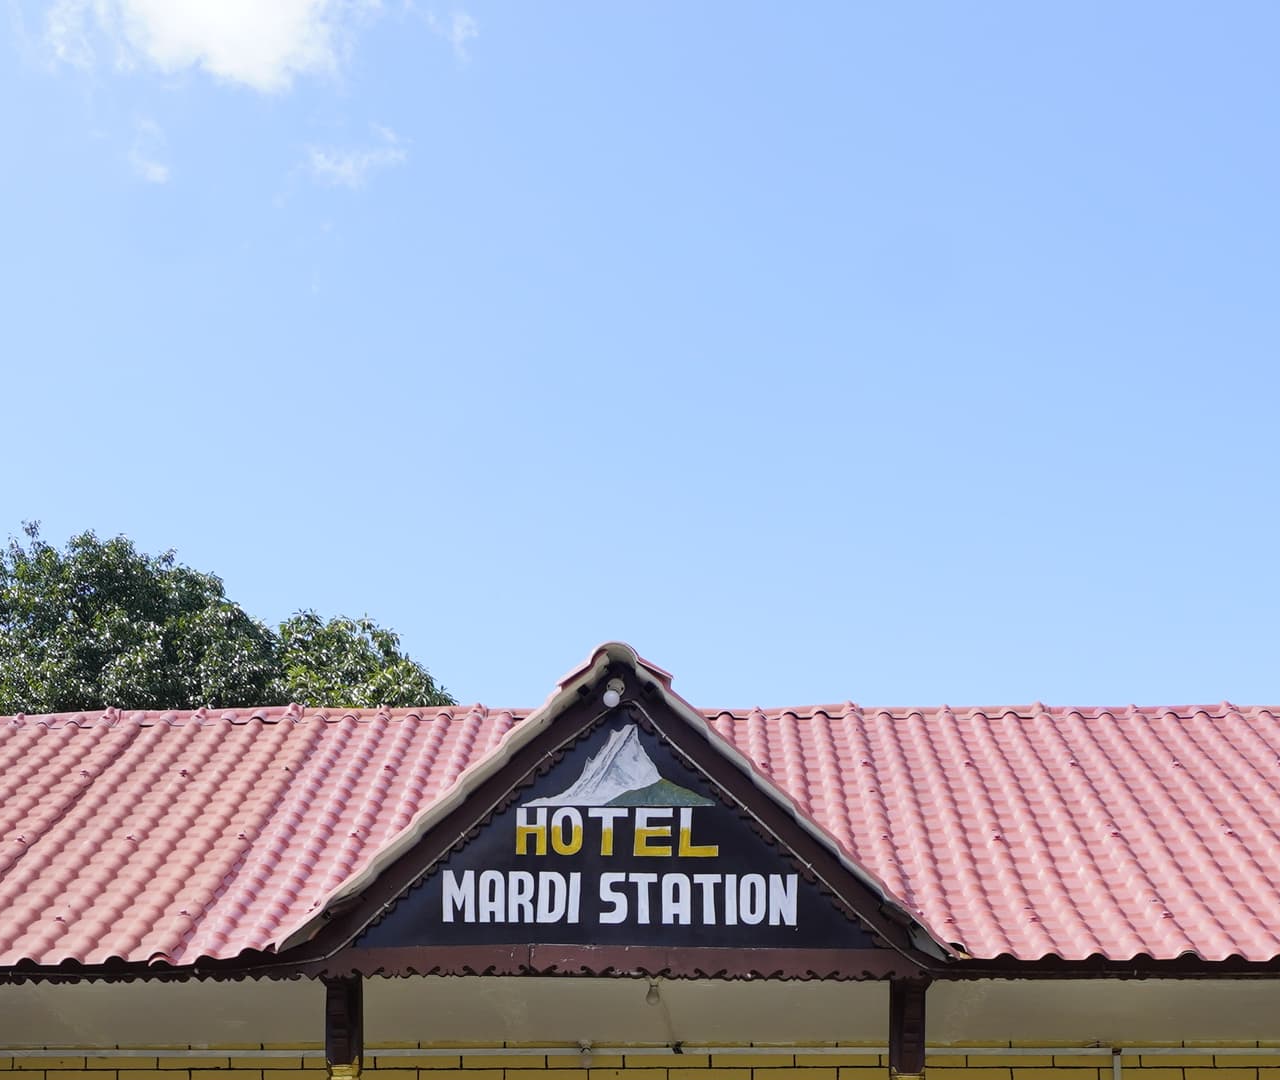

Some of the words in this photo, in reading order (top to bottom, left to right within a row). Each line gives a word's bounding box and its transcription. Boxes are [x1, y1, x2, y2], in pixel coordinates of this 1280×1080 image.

[515, 806, 719, 857] HOTEL
[442, 869, 582, 924] MARDI
[599, 871, 798, 926] STATION
